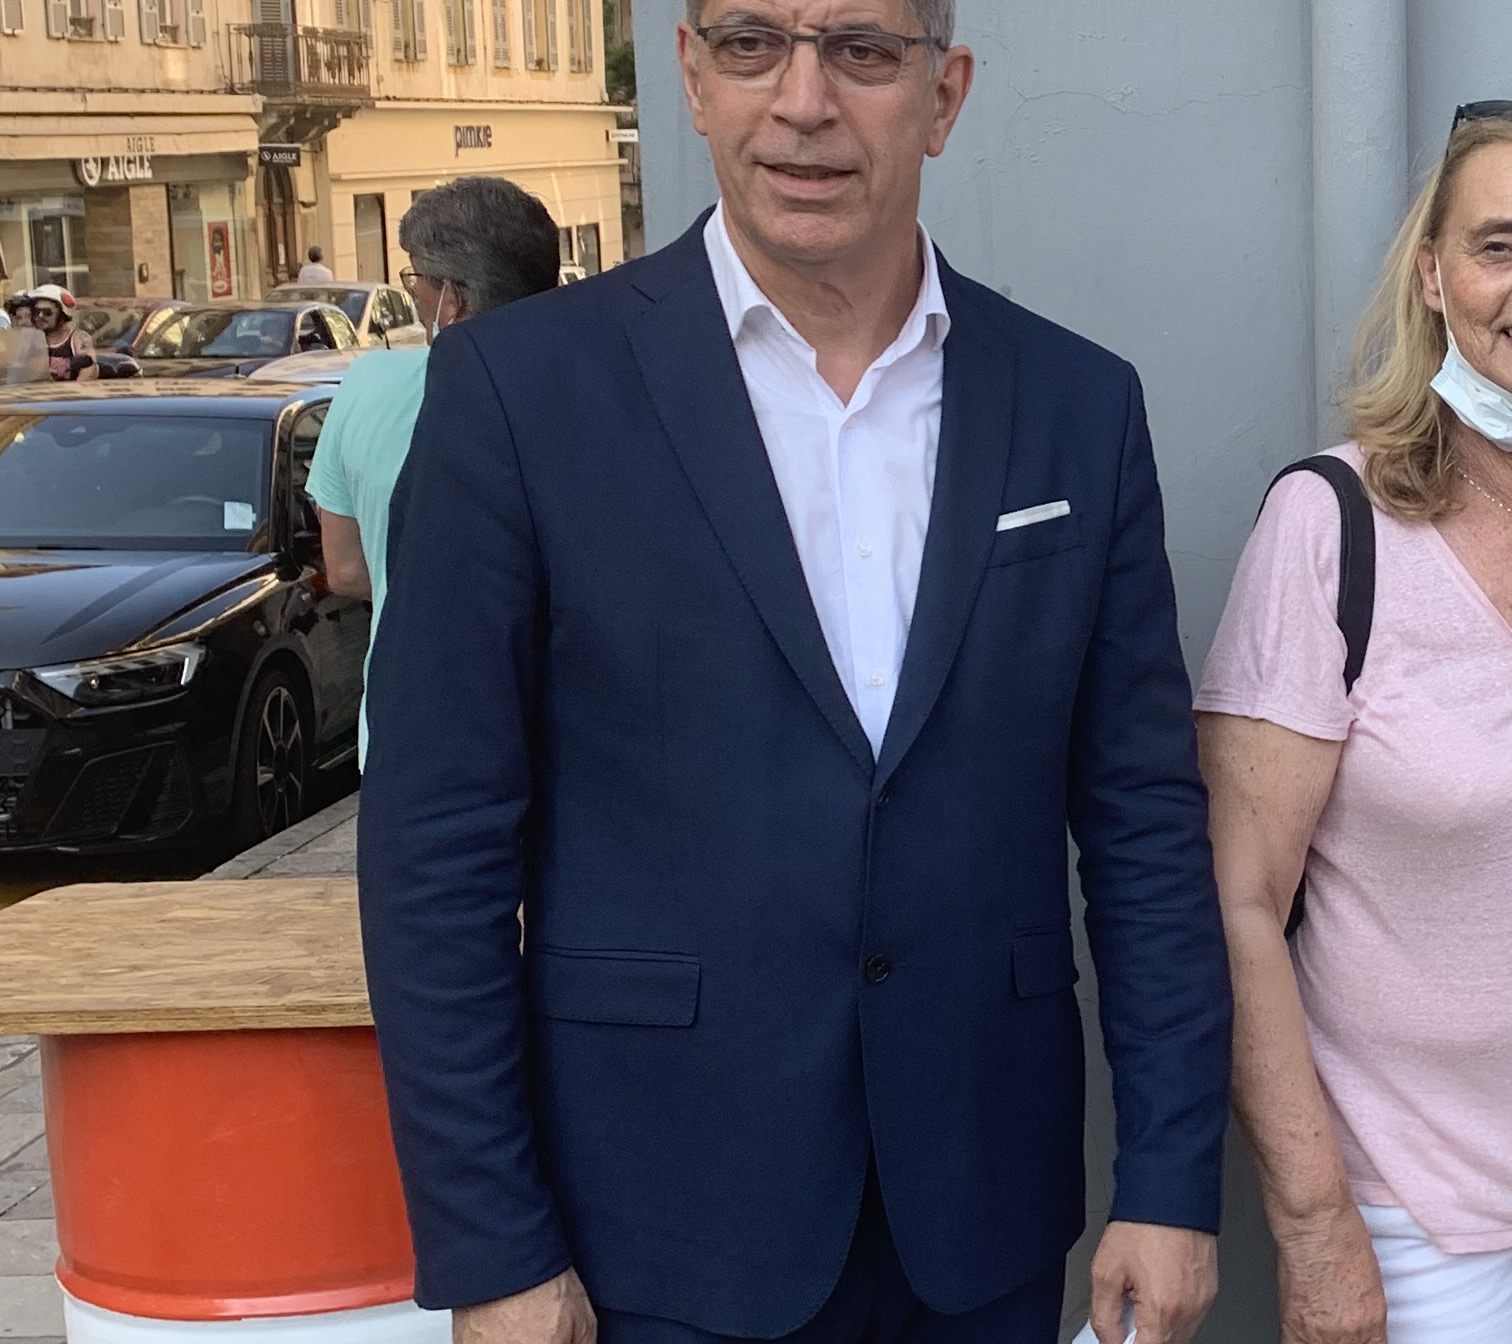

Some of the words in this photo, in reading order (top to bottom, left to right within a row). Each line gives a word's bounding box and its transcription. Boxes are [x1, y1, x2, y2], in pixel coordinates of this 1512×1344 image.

[126, 136, 156, 153] AIGLE
[272, 152, 297, 160] AIGLE
[107, 155, 153, 180] AIGLE
